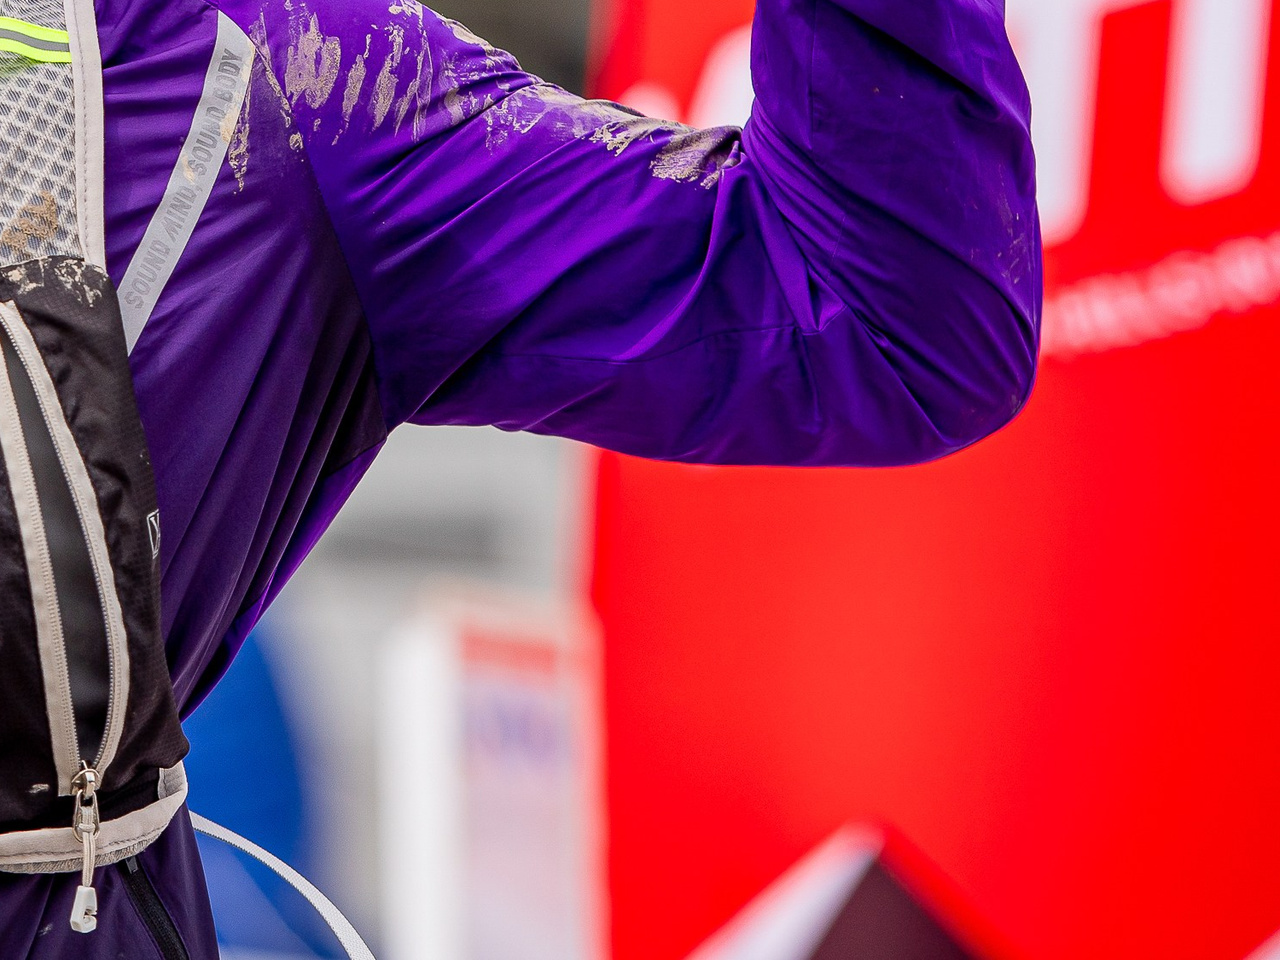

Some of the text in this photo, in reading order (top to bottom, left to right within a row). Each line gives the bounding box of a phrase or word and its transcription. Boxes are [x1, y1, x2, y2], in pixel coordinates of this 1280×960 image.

[124, 239, 171, 309] SOUND
[187, 106, 227, 176] SOUND
[213, 48, 242, 103] BODY
